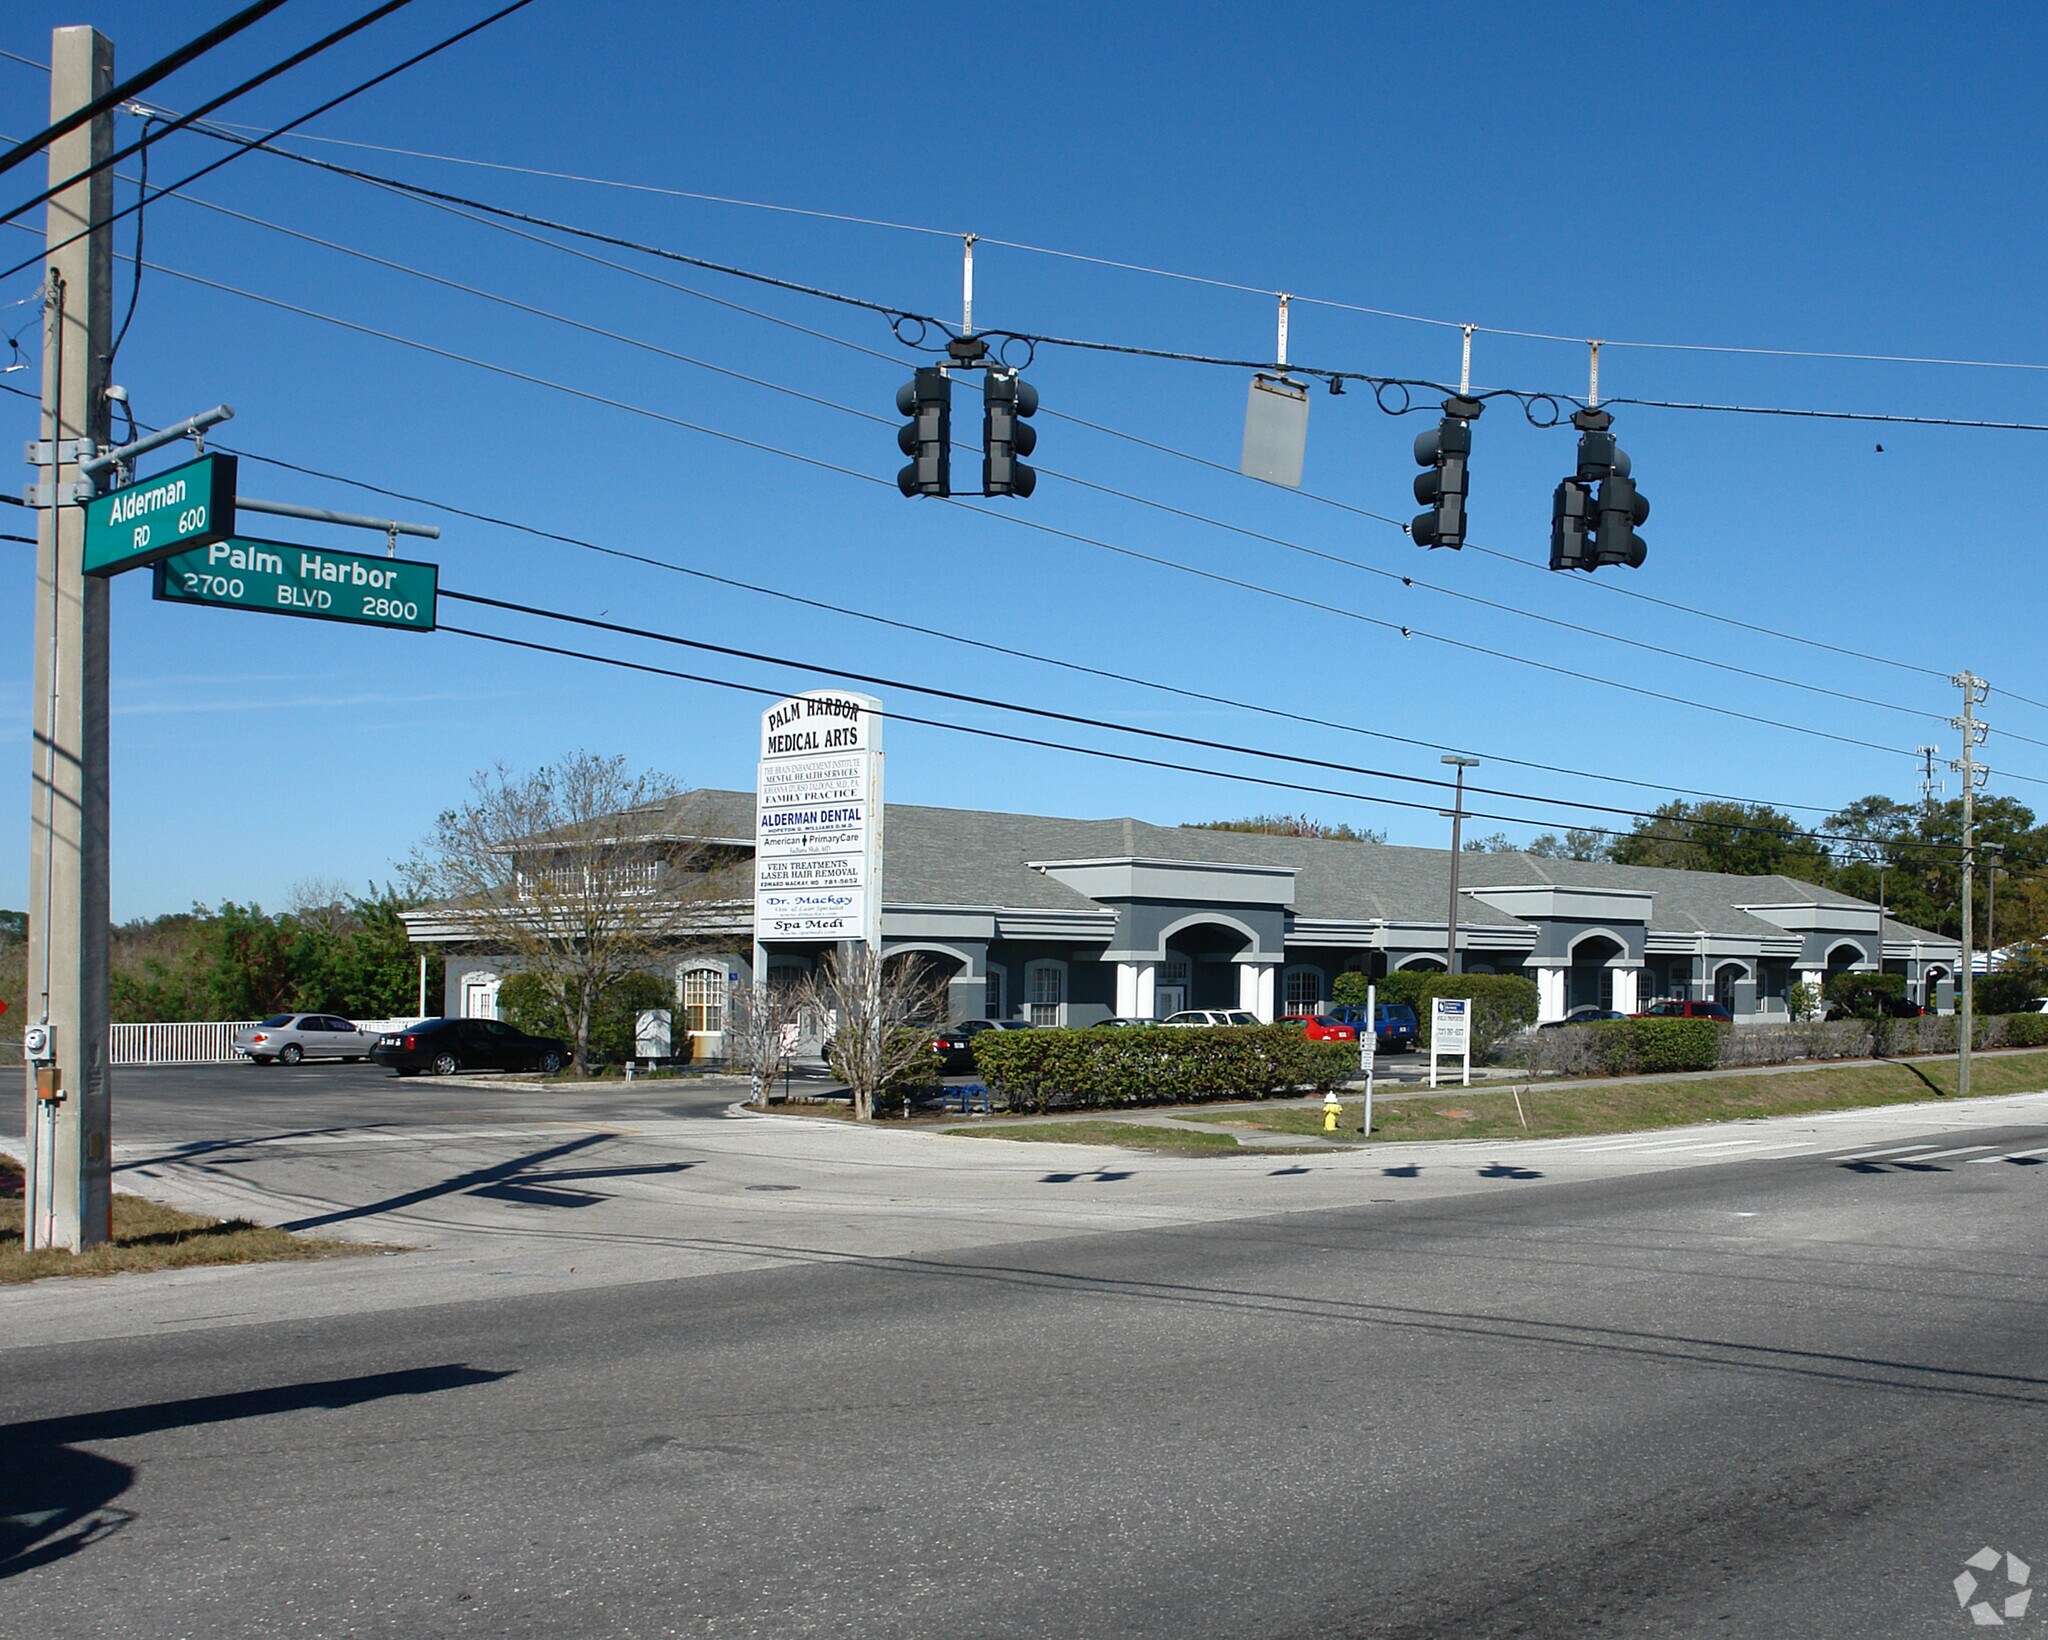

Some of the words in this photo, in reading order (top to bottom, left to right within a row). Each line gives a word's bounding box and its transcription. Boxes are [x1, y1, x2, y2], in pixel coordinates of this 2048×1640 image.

[109, 479, 186, 526] Alderman
[133, 525, 151, 549] RD
[178, 505, 206, 534] 600
[208, 541, 283, 574] Palm
[300, 553, 398, 589] Harbor
[183, 572, 245, 599] 2700
[277, 585, 332, 609] BLVD
[362, 596, 418, 620] 2800
[768, 702, 801, 732] PALM
[807, 697, 859, 722] HARBOR
[768, 731, 819, 754] MEDICAL
[824, 726, 858, 748] ARTS
[766, 774, 793, 784] MENTAL
[794, 770, 822, 781] HEALTH
[824, 768, 858, 779] SERVICES
[765, 792, 802, 804] FAMILY
[804, 788, 857, 801] PRACTICE
[761, 810, 818, 827] ALDERMAN
[820, 808, 861, 823] DENTAL
[763, 836, 801, 846] American
[809, 833, 859, 844] PrimaryCare
[761, 871, 789, 880] LASER
[791, 869, 813, 879] HAIR
[815, 866, 858, 878] REMOVAL
[767, 862, 788, 871] VEIN
[790, 859, 848, 870] TREATMENTS
[766, 897, 790, 905] Dr.
[794, 894, 853, 906] Mackay
[773, 920, 801, 931] Spa
[805, 918, 844, 929] Medi
